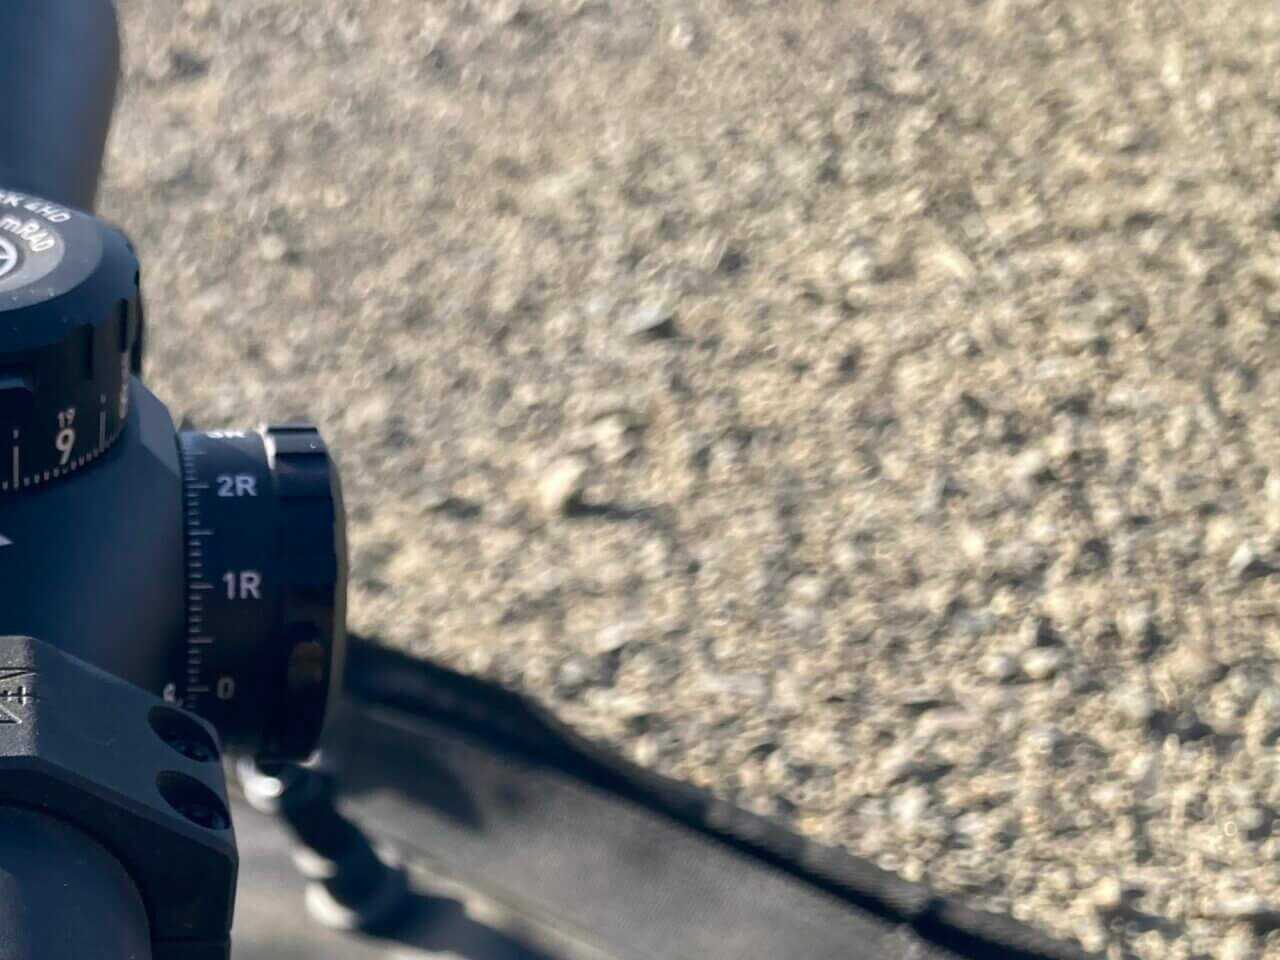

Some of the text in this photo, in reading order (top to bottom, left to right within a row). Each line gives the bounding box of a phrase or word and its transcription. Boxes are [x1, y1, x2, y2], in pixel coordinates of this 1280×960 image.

[55, 427, 76, 465] 9
[216, 474, 258, 497] 2R
[221, 570, 262, 600] 1R
[216, 677, 236, 700] 0
